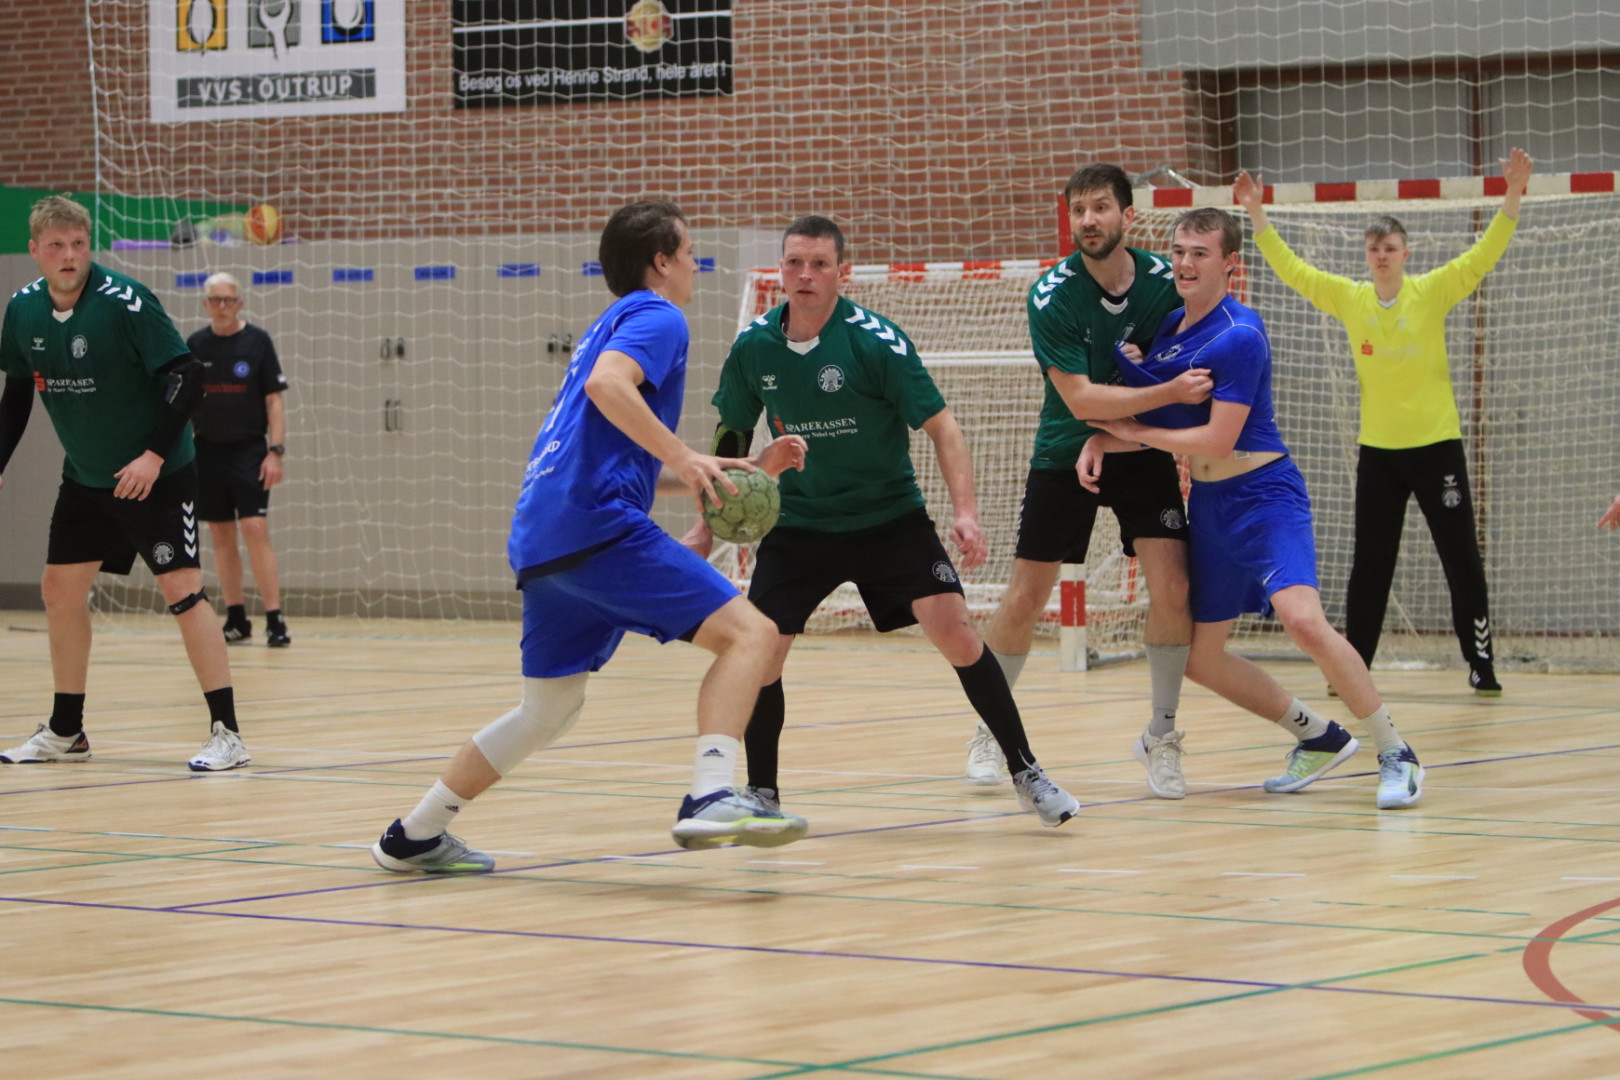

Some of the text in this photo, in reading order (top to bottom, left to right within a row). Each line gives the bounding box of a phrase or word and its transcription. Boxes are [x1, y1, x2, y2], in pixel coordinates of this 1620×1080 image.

[198, 75, 353, 100] VVS OUTRUP
[459, 73, 502, 92] Besøg
[505, 76, 521, 89] os
[524, 70, 550, 88] ved
[553, 70, 600, 86] Henne
[656, 62, 687, 80] hele
[784, 417, 857, 433] SPAREKASSEN
